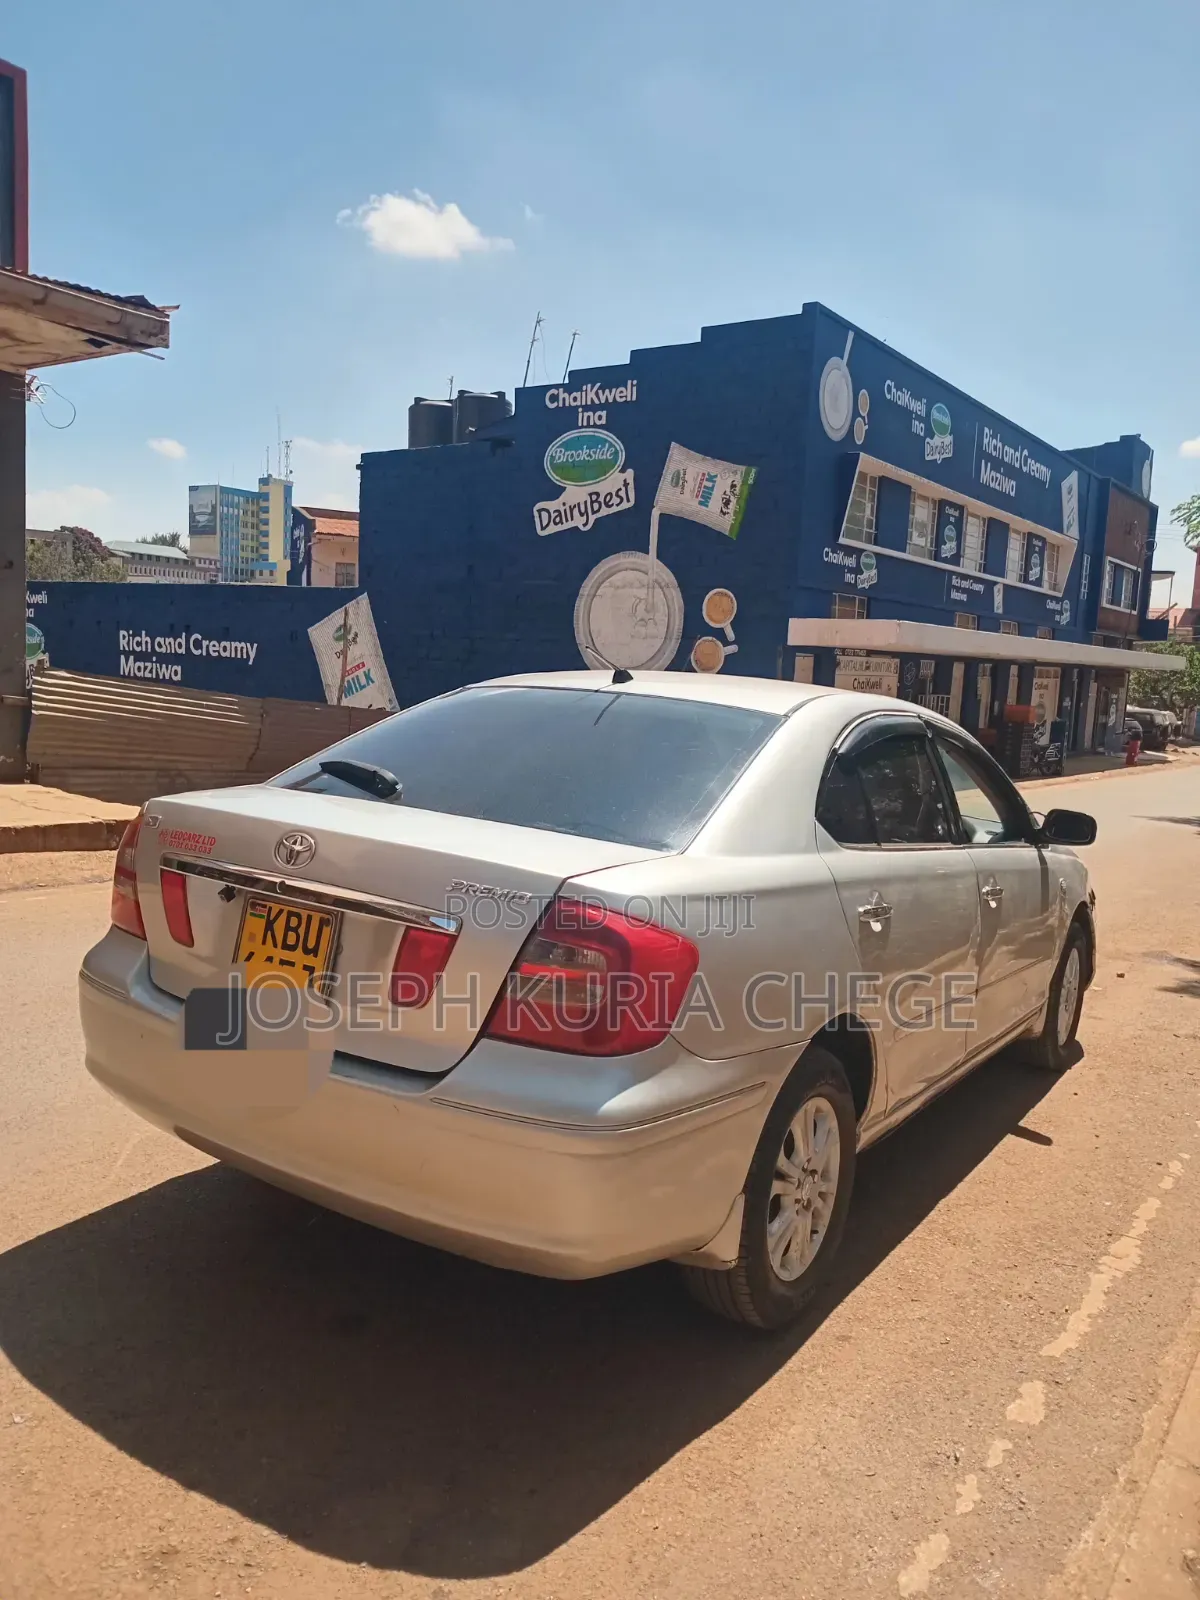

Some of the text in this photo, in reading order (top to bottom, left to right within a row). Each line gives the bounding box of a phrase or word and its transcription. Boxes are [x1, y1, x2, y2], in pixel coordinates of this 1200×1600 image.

[545, 380, 637, 409] ChaiKweli
[884, 379, 927, 418] ChaiKweli
[578, 408, 607, 427] ina
[911, 416, 925, 437] ina
[552, 440, 616, 464] Brookside
[926, 440, 953, 462] DairyBest
[983, 426, 1051, 489] Rich and Creamy
[698, 471, 719, 508] MILK
[980, 460, 1016, 497] Maziwa
[536, 478, 632, 529] DairyBest
[823, 547, 857, 567] ChaiKweli
[845, 569, 855, 584] ina
[119, 629, 258, 665] Rich and Creamy
[120, 654, 182, 682] Maziwa
[343, 668, 375, 698] MILK
[852, 677, 883, 690] ChaiKweli
[169, 840, 212, 854] 0701 033 033
[170, 830, 216, 846] LEOCARZ LTD
[445, 878, 533, 905] PREMIO
[261, 905, 323, 959] KBU
